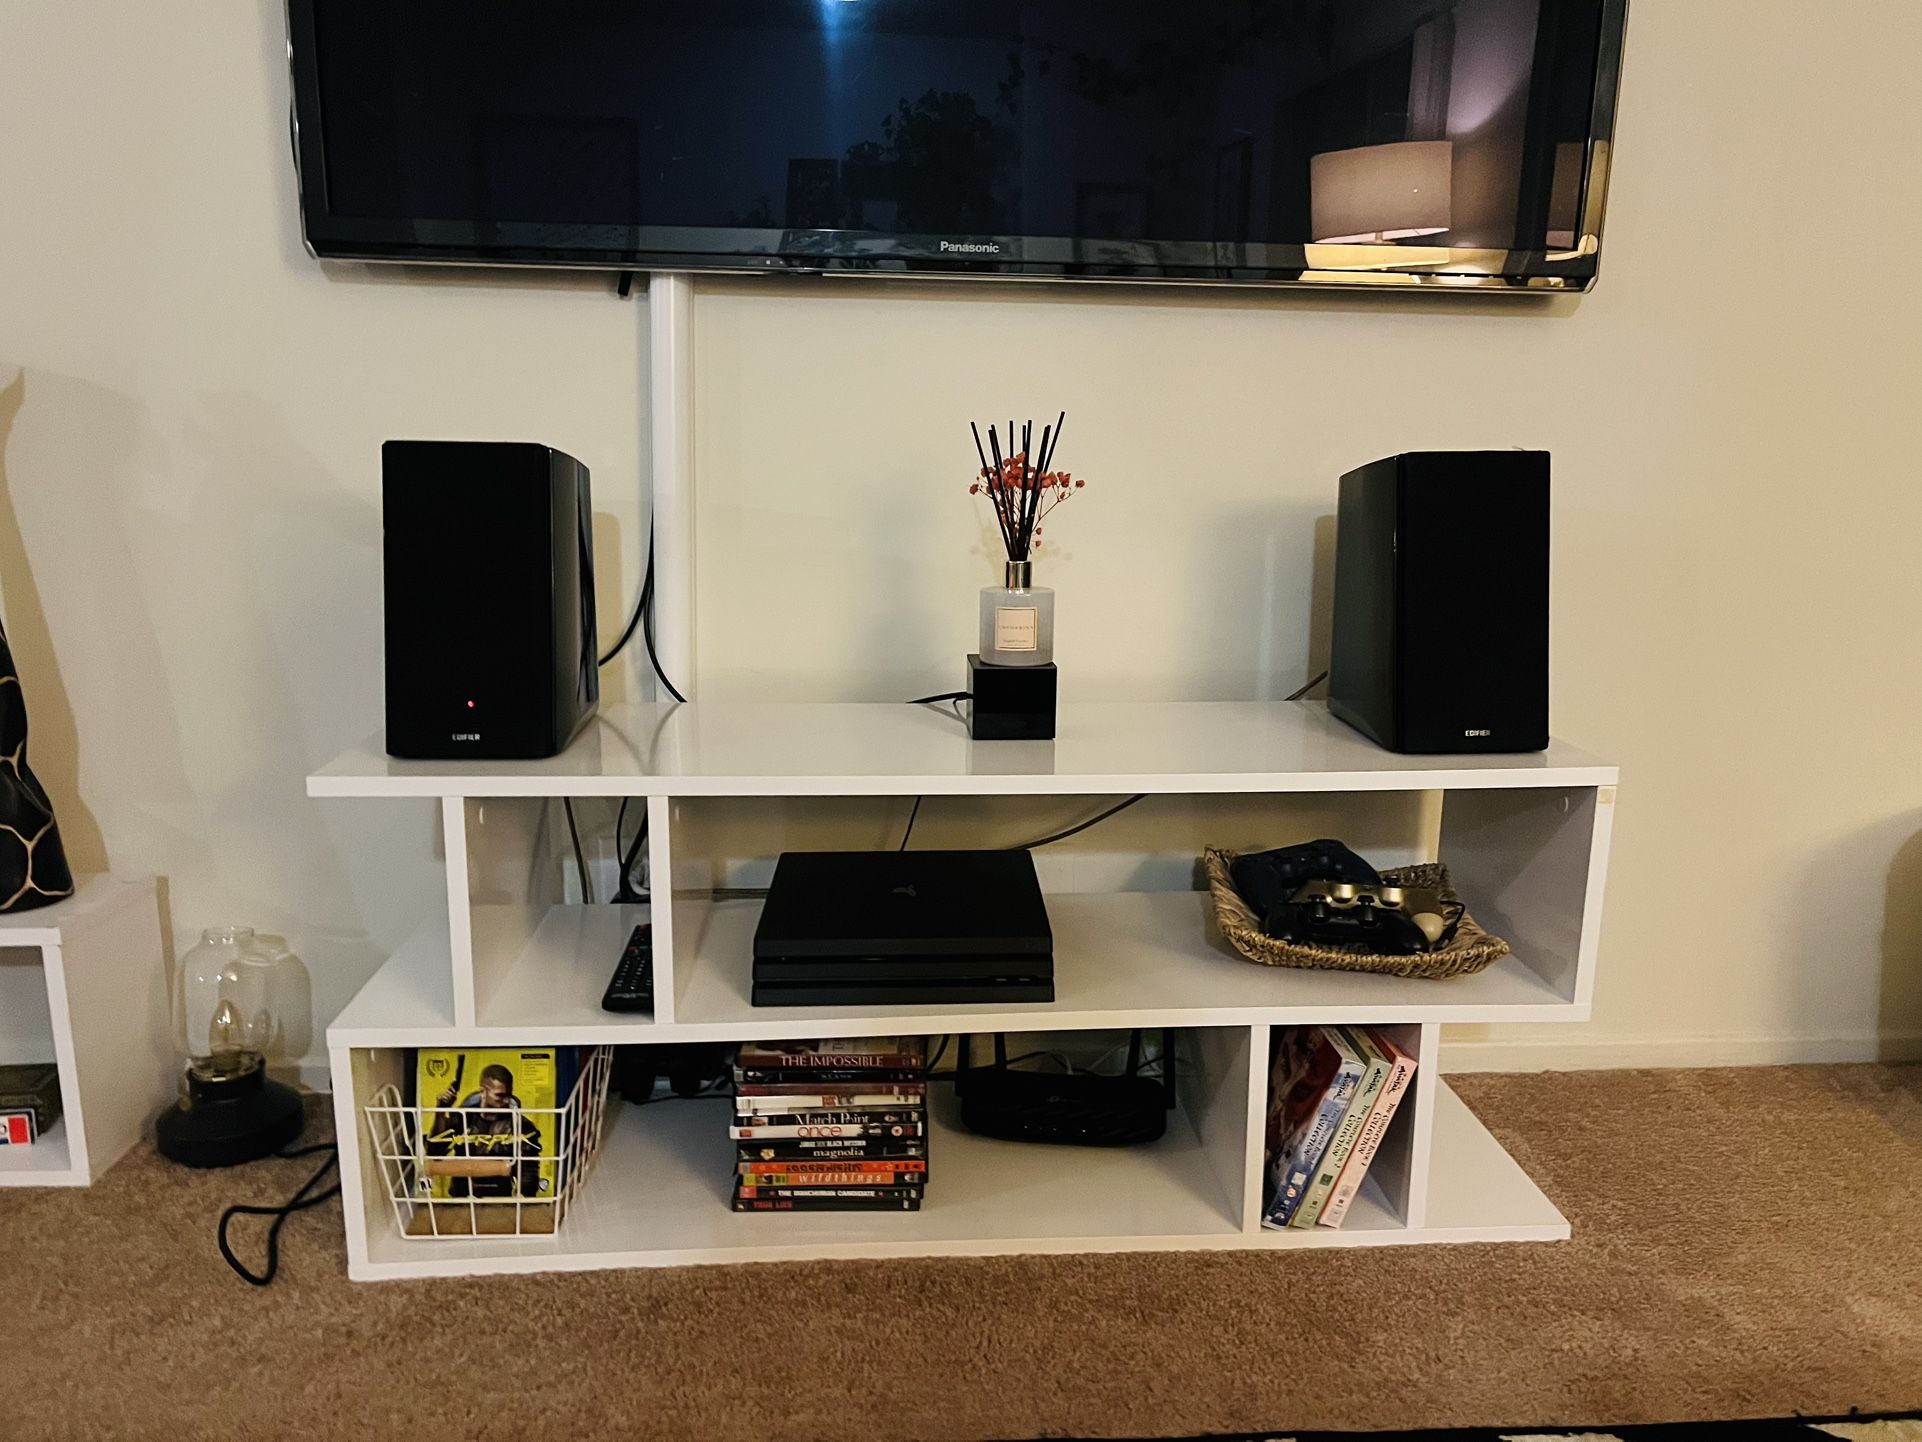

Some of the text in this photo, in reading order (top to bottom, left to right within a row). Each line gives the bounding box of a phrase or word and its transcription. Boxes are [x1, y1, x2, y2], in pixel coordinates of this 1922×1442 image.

[940, 241, 1000, 253] Panasonic
[780, 1055, 884, 1067] THE IMPOSSIBLE
[795, 1111, 869, 1125] Match Point
[797, 1126, 842, 1138] once
[1331, 1114, 1356, 1157] COLLECTION
[1357, 1112, 1382, 1155] COLLECTION
[813, 1147, 864, 1158] magnolia
